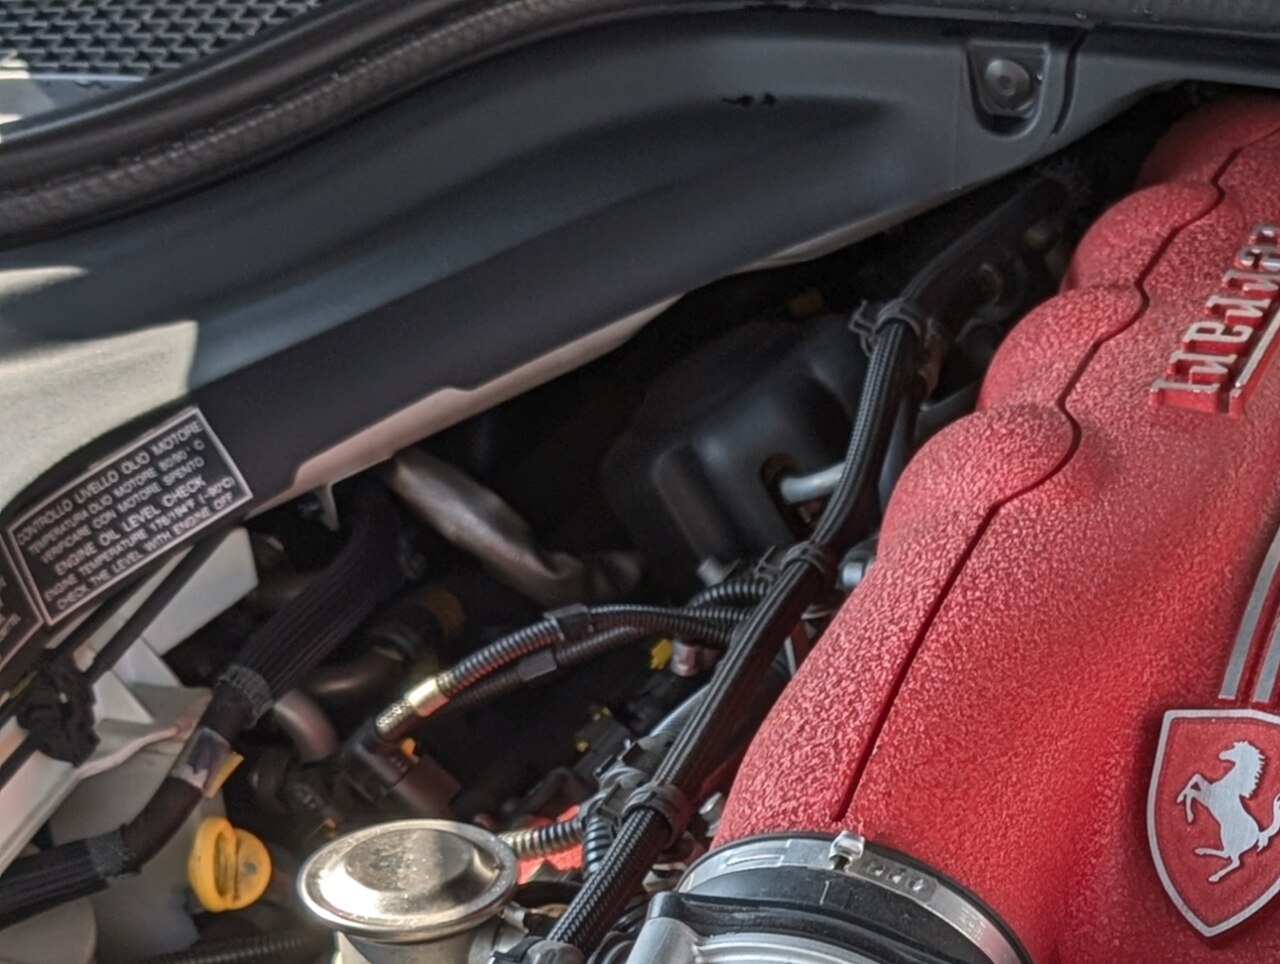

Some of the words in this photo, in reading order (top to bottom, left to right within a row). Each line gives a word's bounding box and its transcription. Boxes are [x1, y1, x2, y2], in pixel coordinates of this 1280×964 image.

[16, 500, 73, 546] CONTROLLO
[75, 471, 120, 504] LIVELLO
[121, 451, 151, 476] OLIO
[151, 420, 204, 456] MOTORE
[28, 511, 89, 555] TEMPERATURA
[88, 493, 113, 516] OLIO
[113, 469, 159, 498] MOTORE
[40, 526, 92, 564] VERIFICARE
[92, 509, 117, 530] CON
[118, 482, 163, 514] MOTORE
[162, 456, 206, 487] SPENTO
[54, 541, 98, 577] ENGINE
[99, 528, 122, 548] OIL
[122, 504, 162, 533] LEVEL
[162, 475, 207, 508] CHECK
[44, 575, 79, 603] ENGINE
[78, 528, 148, 578] TEMPERATURE
[56, 583, 91, 611] CHECK
[89, 569, 111, 588] THE
[112, 550, 144, 574] LEVEL
[144, 530, 172, 552] WITH
[173, 507, 213, 537] ENGINE
[212, 493, 235, 512] OFF
